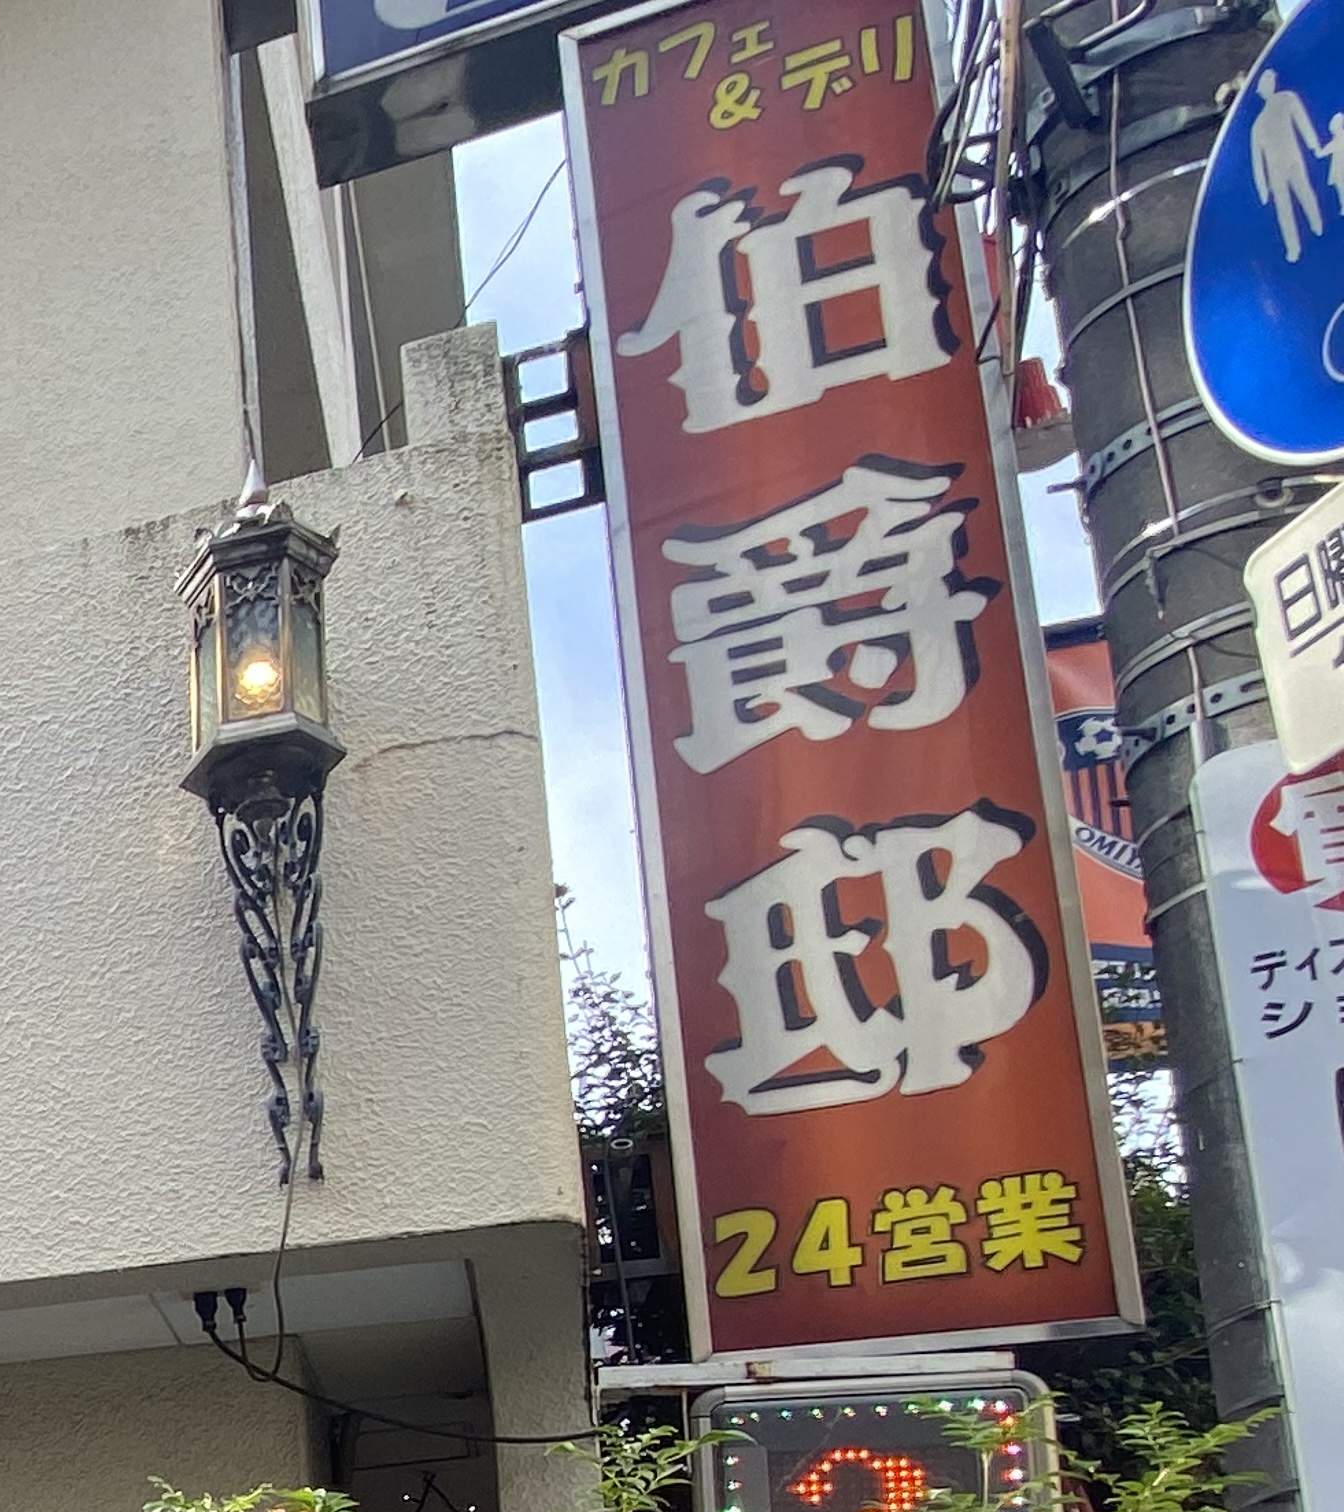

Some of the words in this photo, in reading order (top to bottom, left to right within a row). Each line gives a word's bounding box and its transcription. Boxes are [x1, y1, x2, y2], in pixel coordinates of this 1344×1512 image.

[592, 20, 775, 107] カフェ
[616, 152, 1049, 1122] 伯爵邸
[1261, 996, 1344, 1040] シ
[714, 1167, 1084, 1299] 24営業
